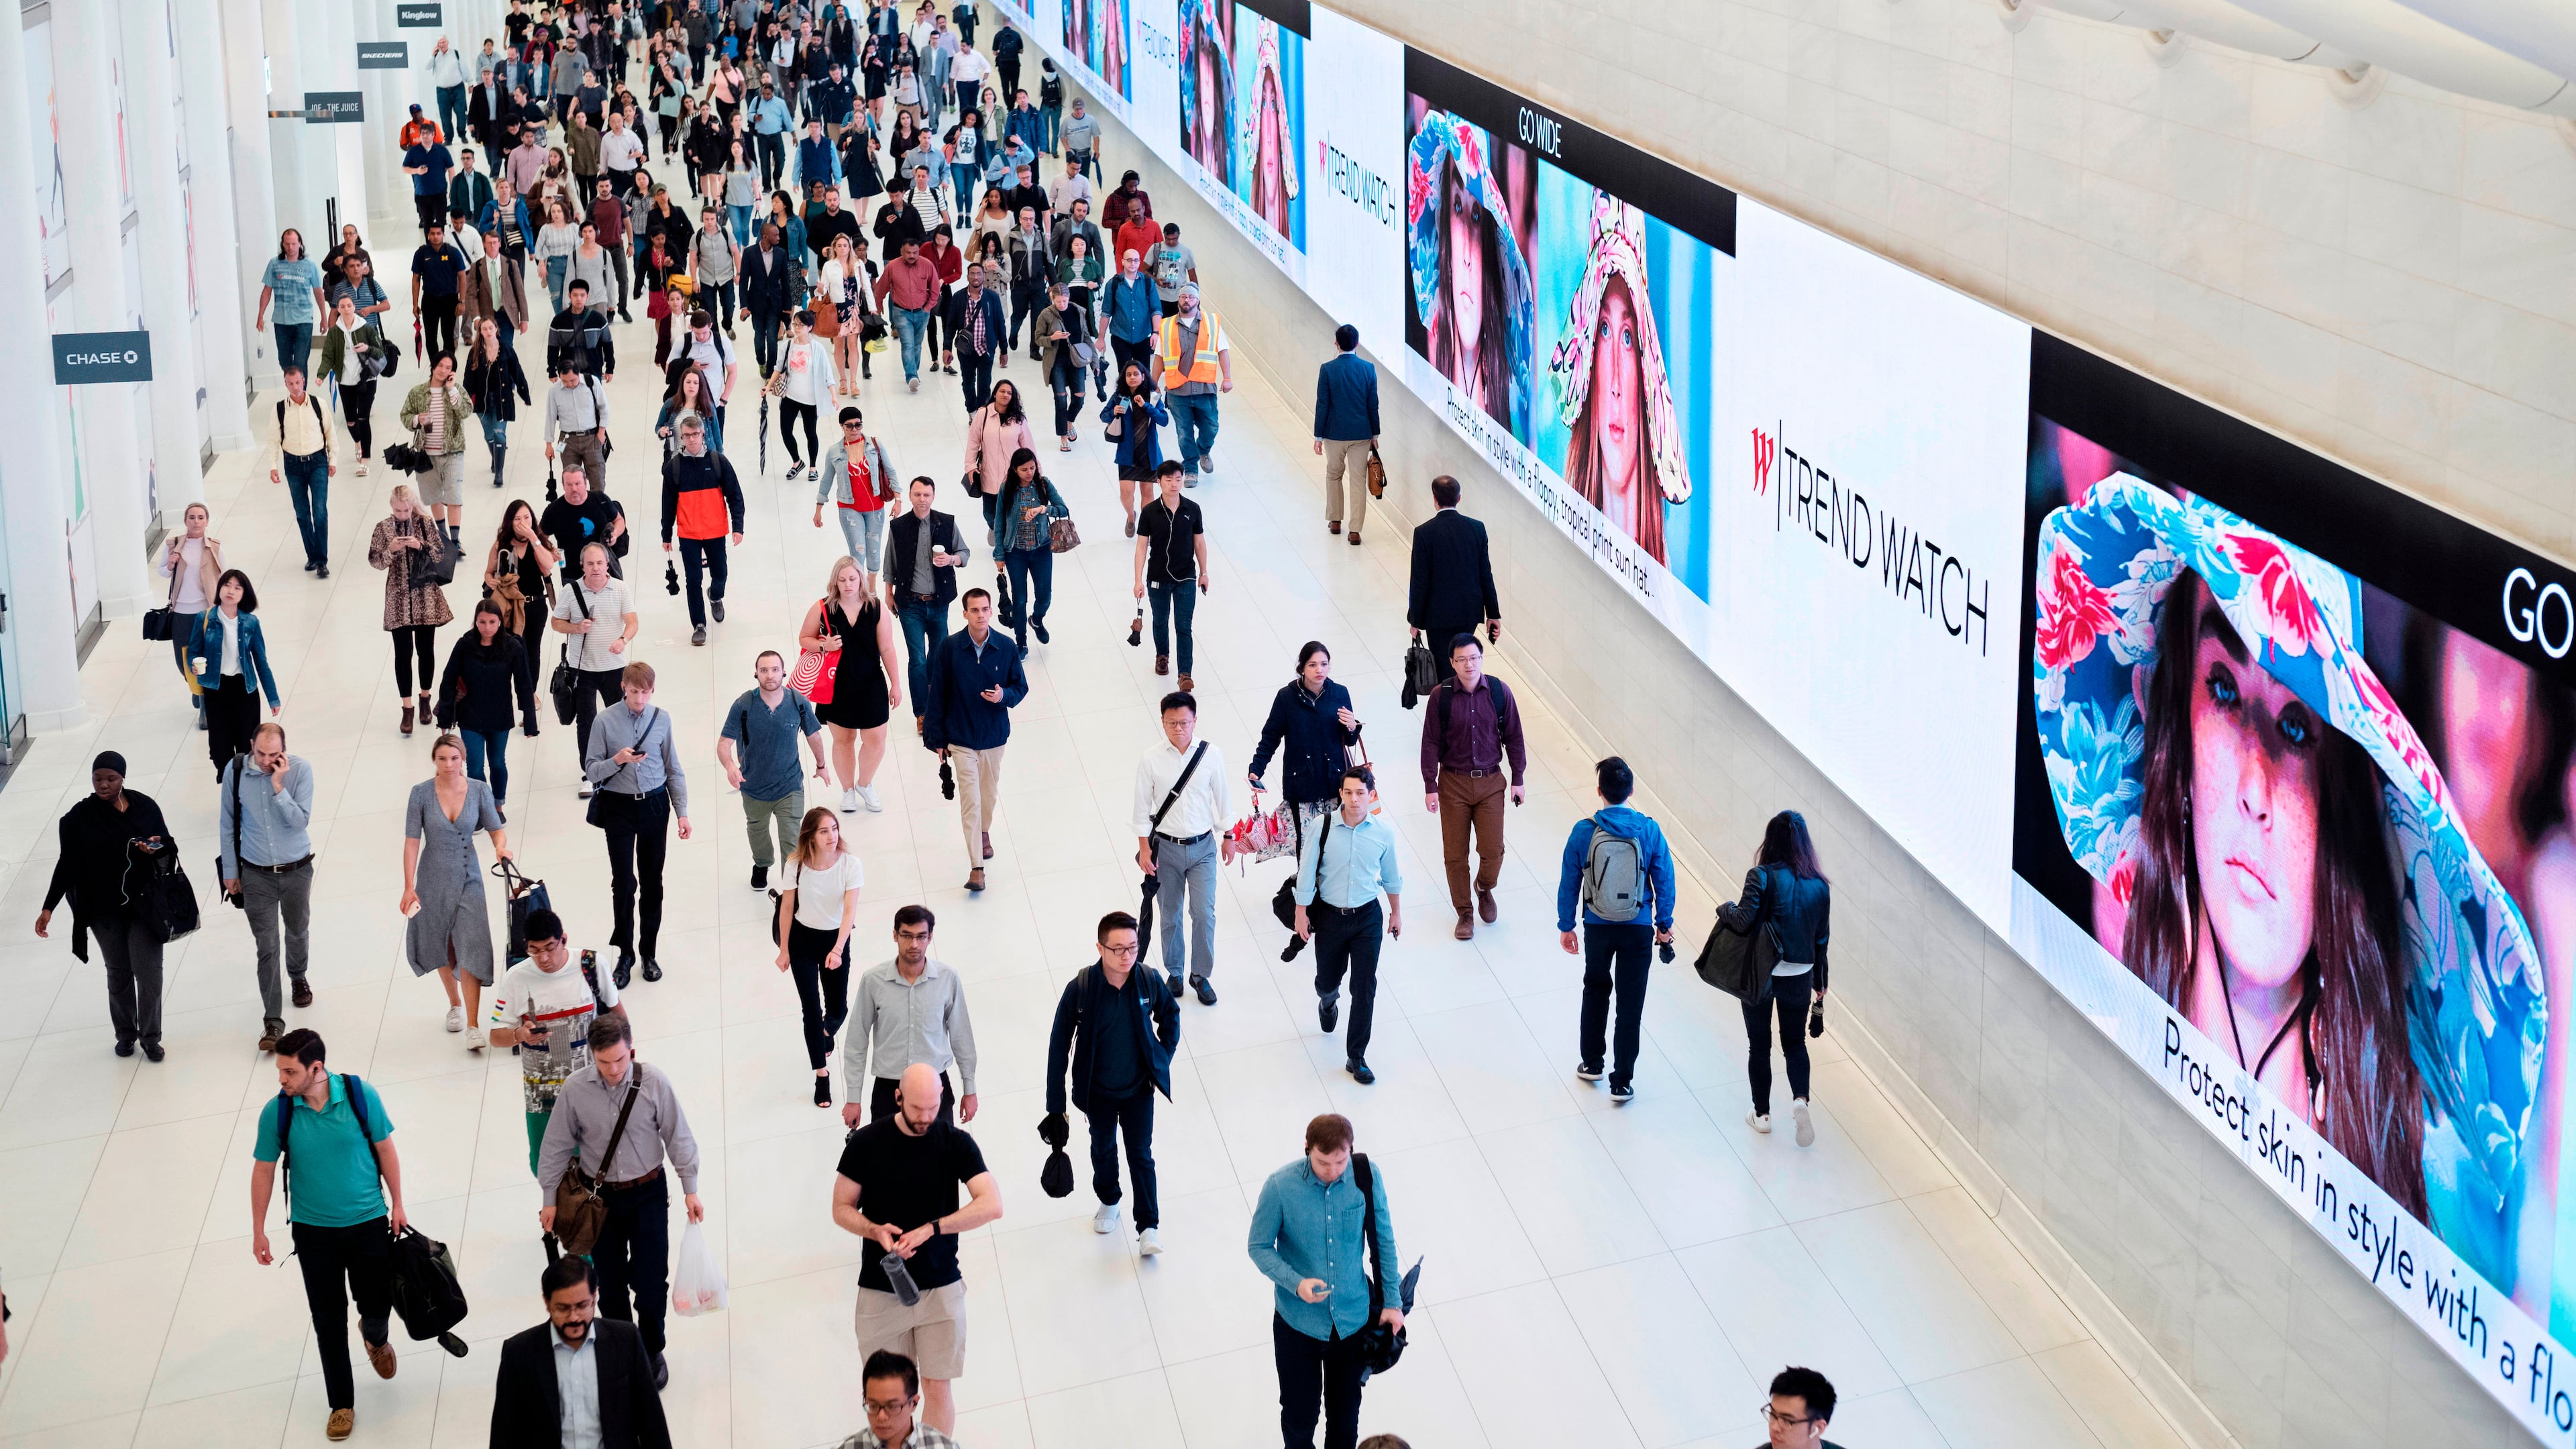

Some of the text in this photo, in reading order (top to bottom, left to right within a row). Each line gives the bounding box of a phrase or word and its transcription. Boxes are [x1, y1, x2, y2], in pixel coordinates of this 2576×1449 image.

[401, 11, 437, 21] Kingkow
[327, 103, 339, 112] THE
[341, 103, 359, 112] JUICE
[1519, 106, 1562, 159] GO WIDE
[1330, 146, 1360, 203] TREND
[1362, 166, 1395, 231] WATCH
[66, 352, 121, 365] CHASE
[1447, 386, 1470, 433] Protect
[1472, 409, 1484, 446] skin
[1485, 420, 1492, 453] in
[1493, 435, 1509, 475] style
[1511, 447, 1525, 484] with
[1527, 470, 1532, 488] a
[1534, 463, 1559, 523] floppy,
[1561, 494, 1591, 542] tropical
[1593, 522, 1613, 563] print
[1615, 547, 1630, 579] sun
[1784, 446, 1872, 569] TREND
[1880, 510, 1988, 657] WATCH
[2503, 568, 2574, 659] GO
[2163, 1015, 2574, 1433] Protect skin in style with a flo
